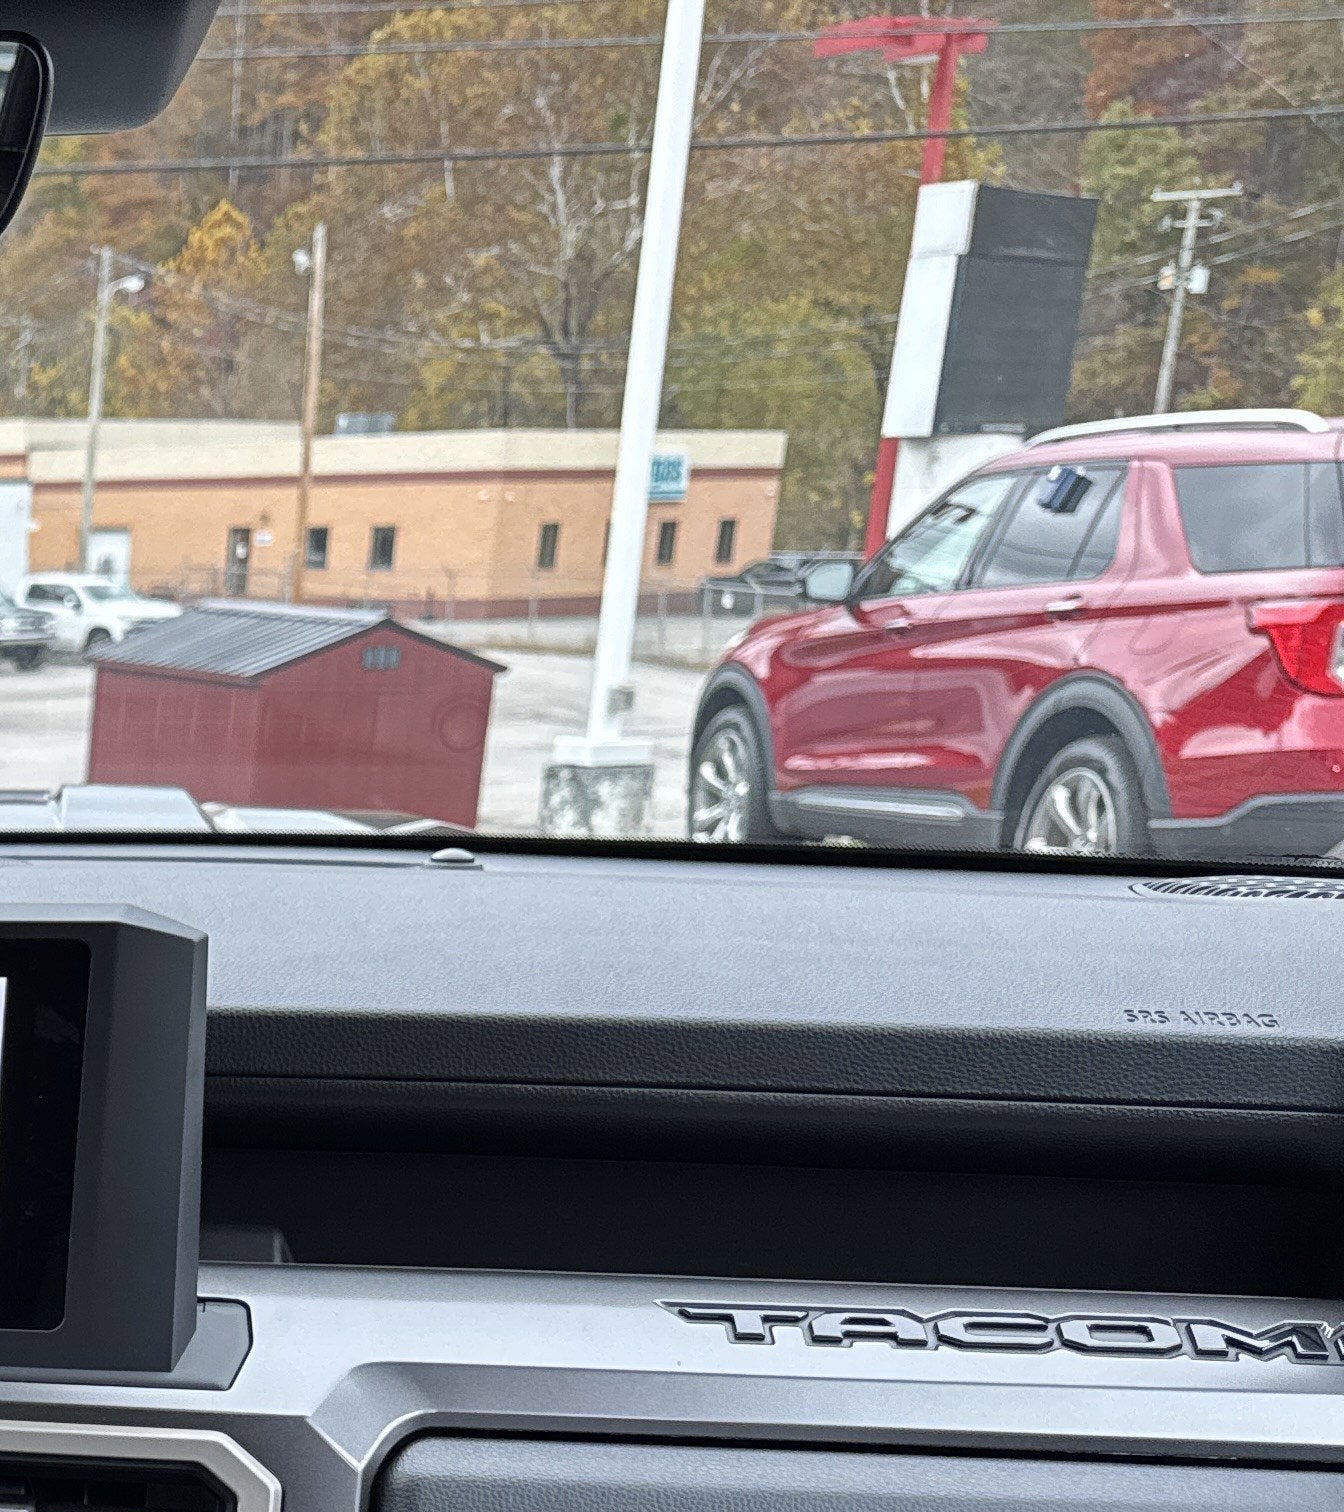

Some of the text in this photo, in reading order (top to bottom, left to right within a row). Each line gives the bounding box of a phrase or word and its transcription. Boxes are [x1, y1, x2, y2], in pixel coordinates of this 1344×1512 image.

[1123, 1009, 1281, 1028] SRS AIRBAG
[654, 1299, 1344, 1365] TACOM
